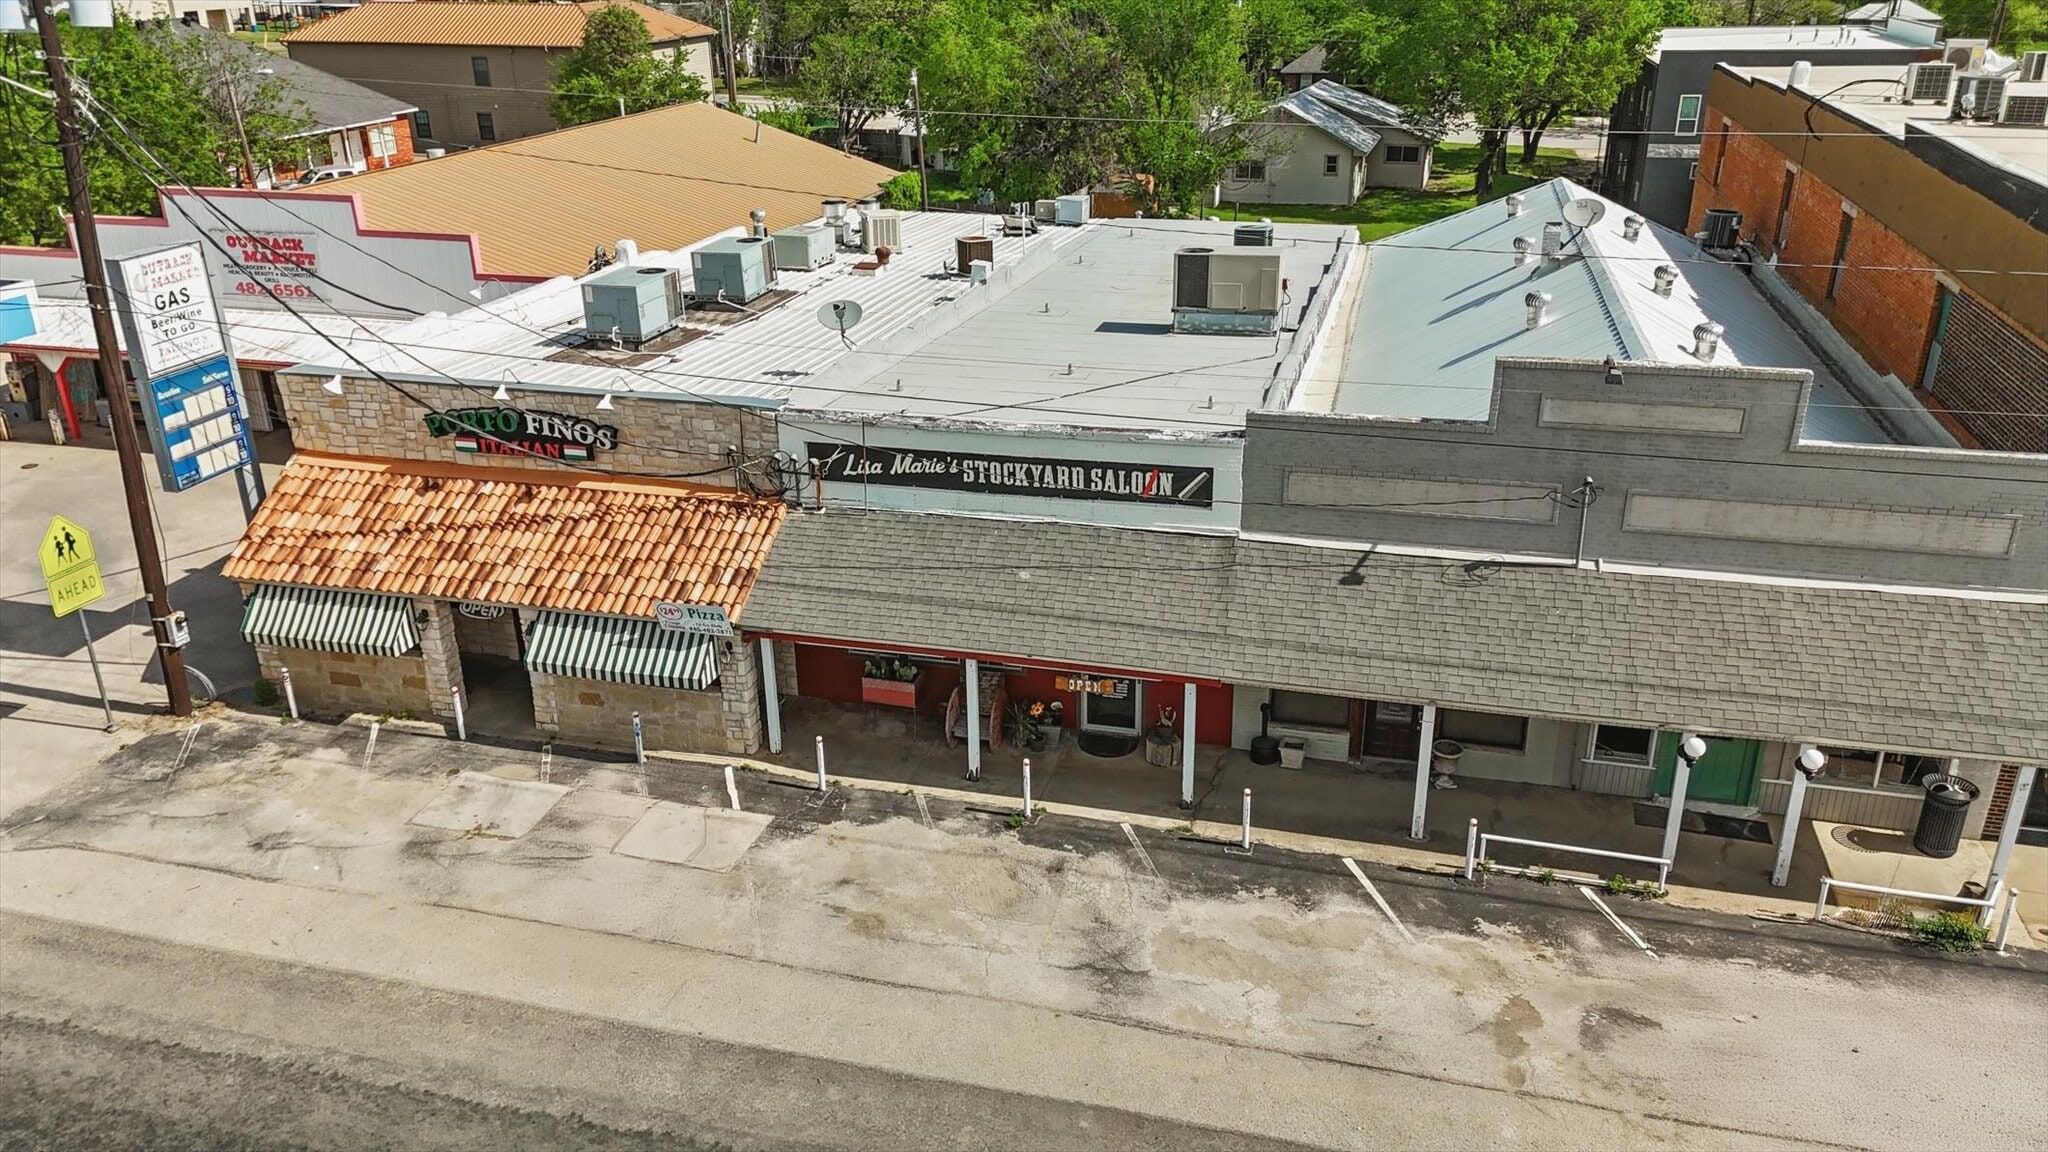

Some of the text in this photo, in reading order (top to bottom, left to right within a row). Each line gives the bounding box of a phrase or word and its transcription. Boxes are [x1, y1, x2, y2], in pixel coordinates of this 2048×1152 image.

[242, 250, 316, 266] MARKET
[155, 287, 190, 311] GAS
[162, 321, 196, 338] TO GO
[426, 408, 612, 450] PORTO FINOS
[479, 438, 560, 459] ITALIAN
[843, 453, 883, 476] Lisa
[890, 452, 960, 476] Marie's
[963, 459, 1085, 489] STOCKYARD
[57, 575, 97, 602] AHEAD
[462, 602, 499, 618] OPEN
[687, 608, 724, 621] Pizza
[1068, 679, 1101, 693] OPEN
